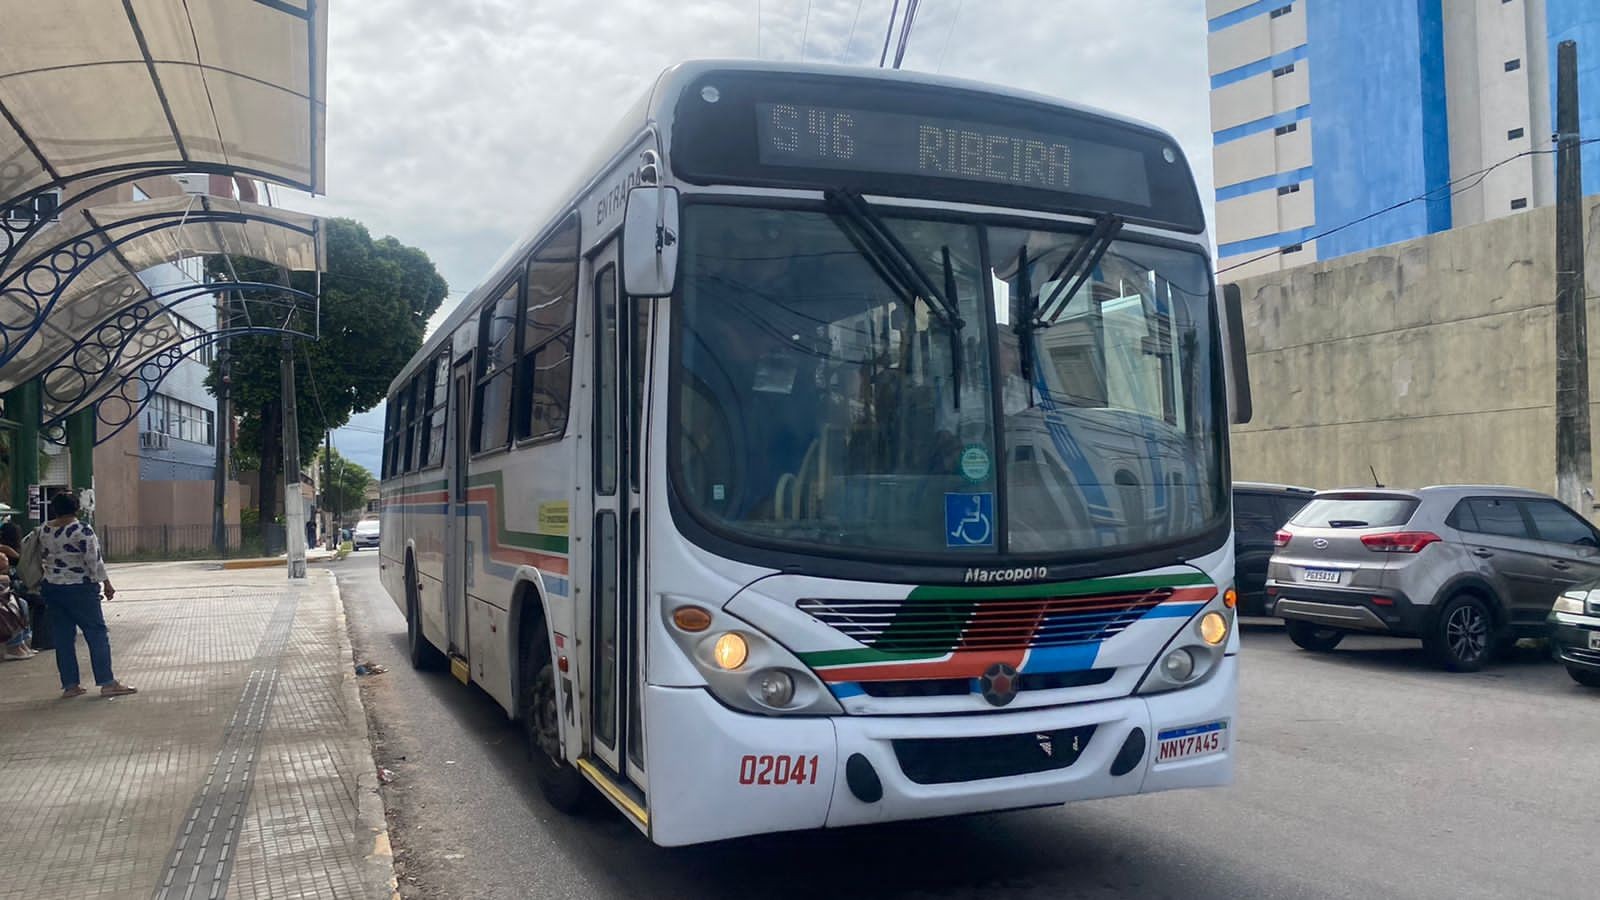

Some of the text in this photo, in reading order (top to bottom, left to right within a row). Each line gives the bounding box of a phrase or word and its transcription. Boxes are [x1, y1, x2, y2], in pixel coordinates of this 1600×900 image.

[772, 102, 1072, 187] S46 RIBEIRA
[964, 566, 1048, 583] Marcopolo
[1160, 732, 1219, 760] NNY7A45
[738, 754, 819, 785] 02041
